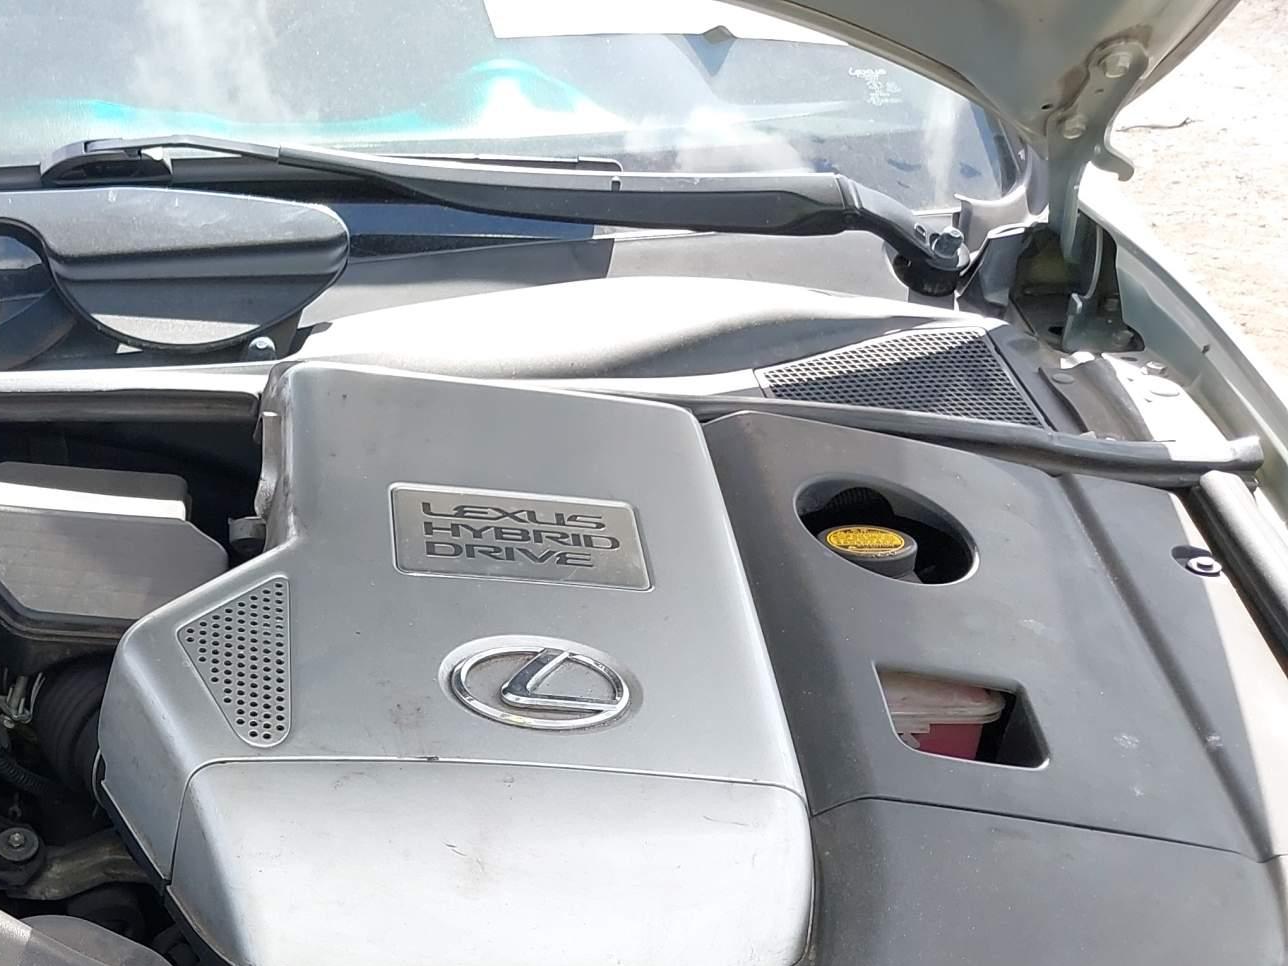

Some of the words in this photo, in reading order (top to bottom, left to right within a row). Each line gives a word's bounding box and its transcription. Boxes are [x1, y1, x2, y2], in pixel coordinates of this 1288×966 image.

[420, 501, 606, 531] LEXUS
[423, 520, 620, 551] HYBRID
[424, 540, 593, 568] DRIVE
